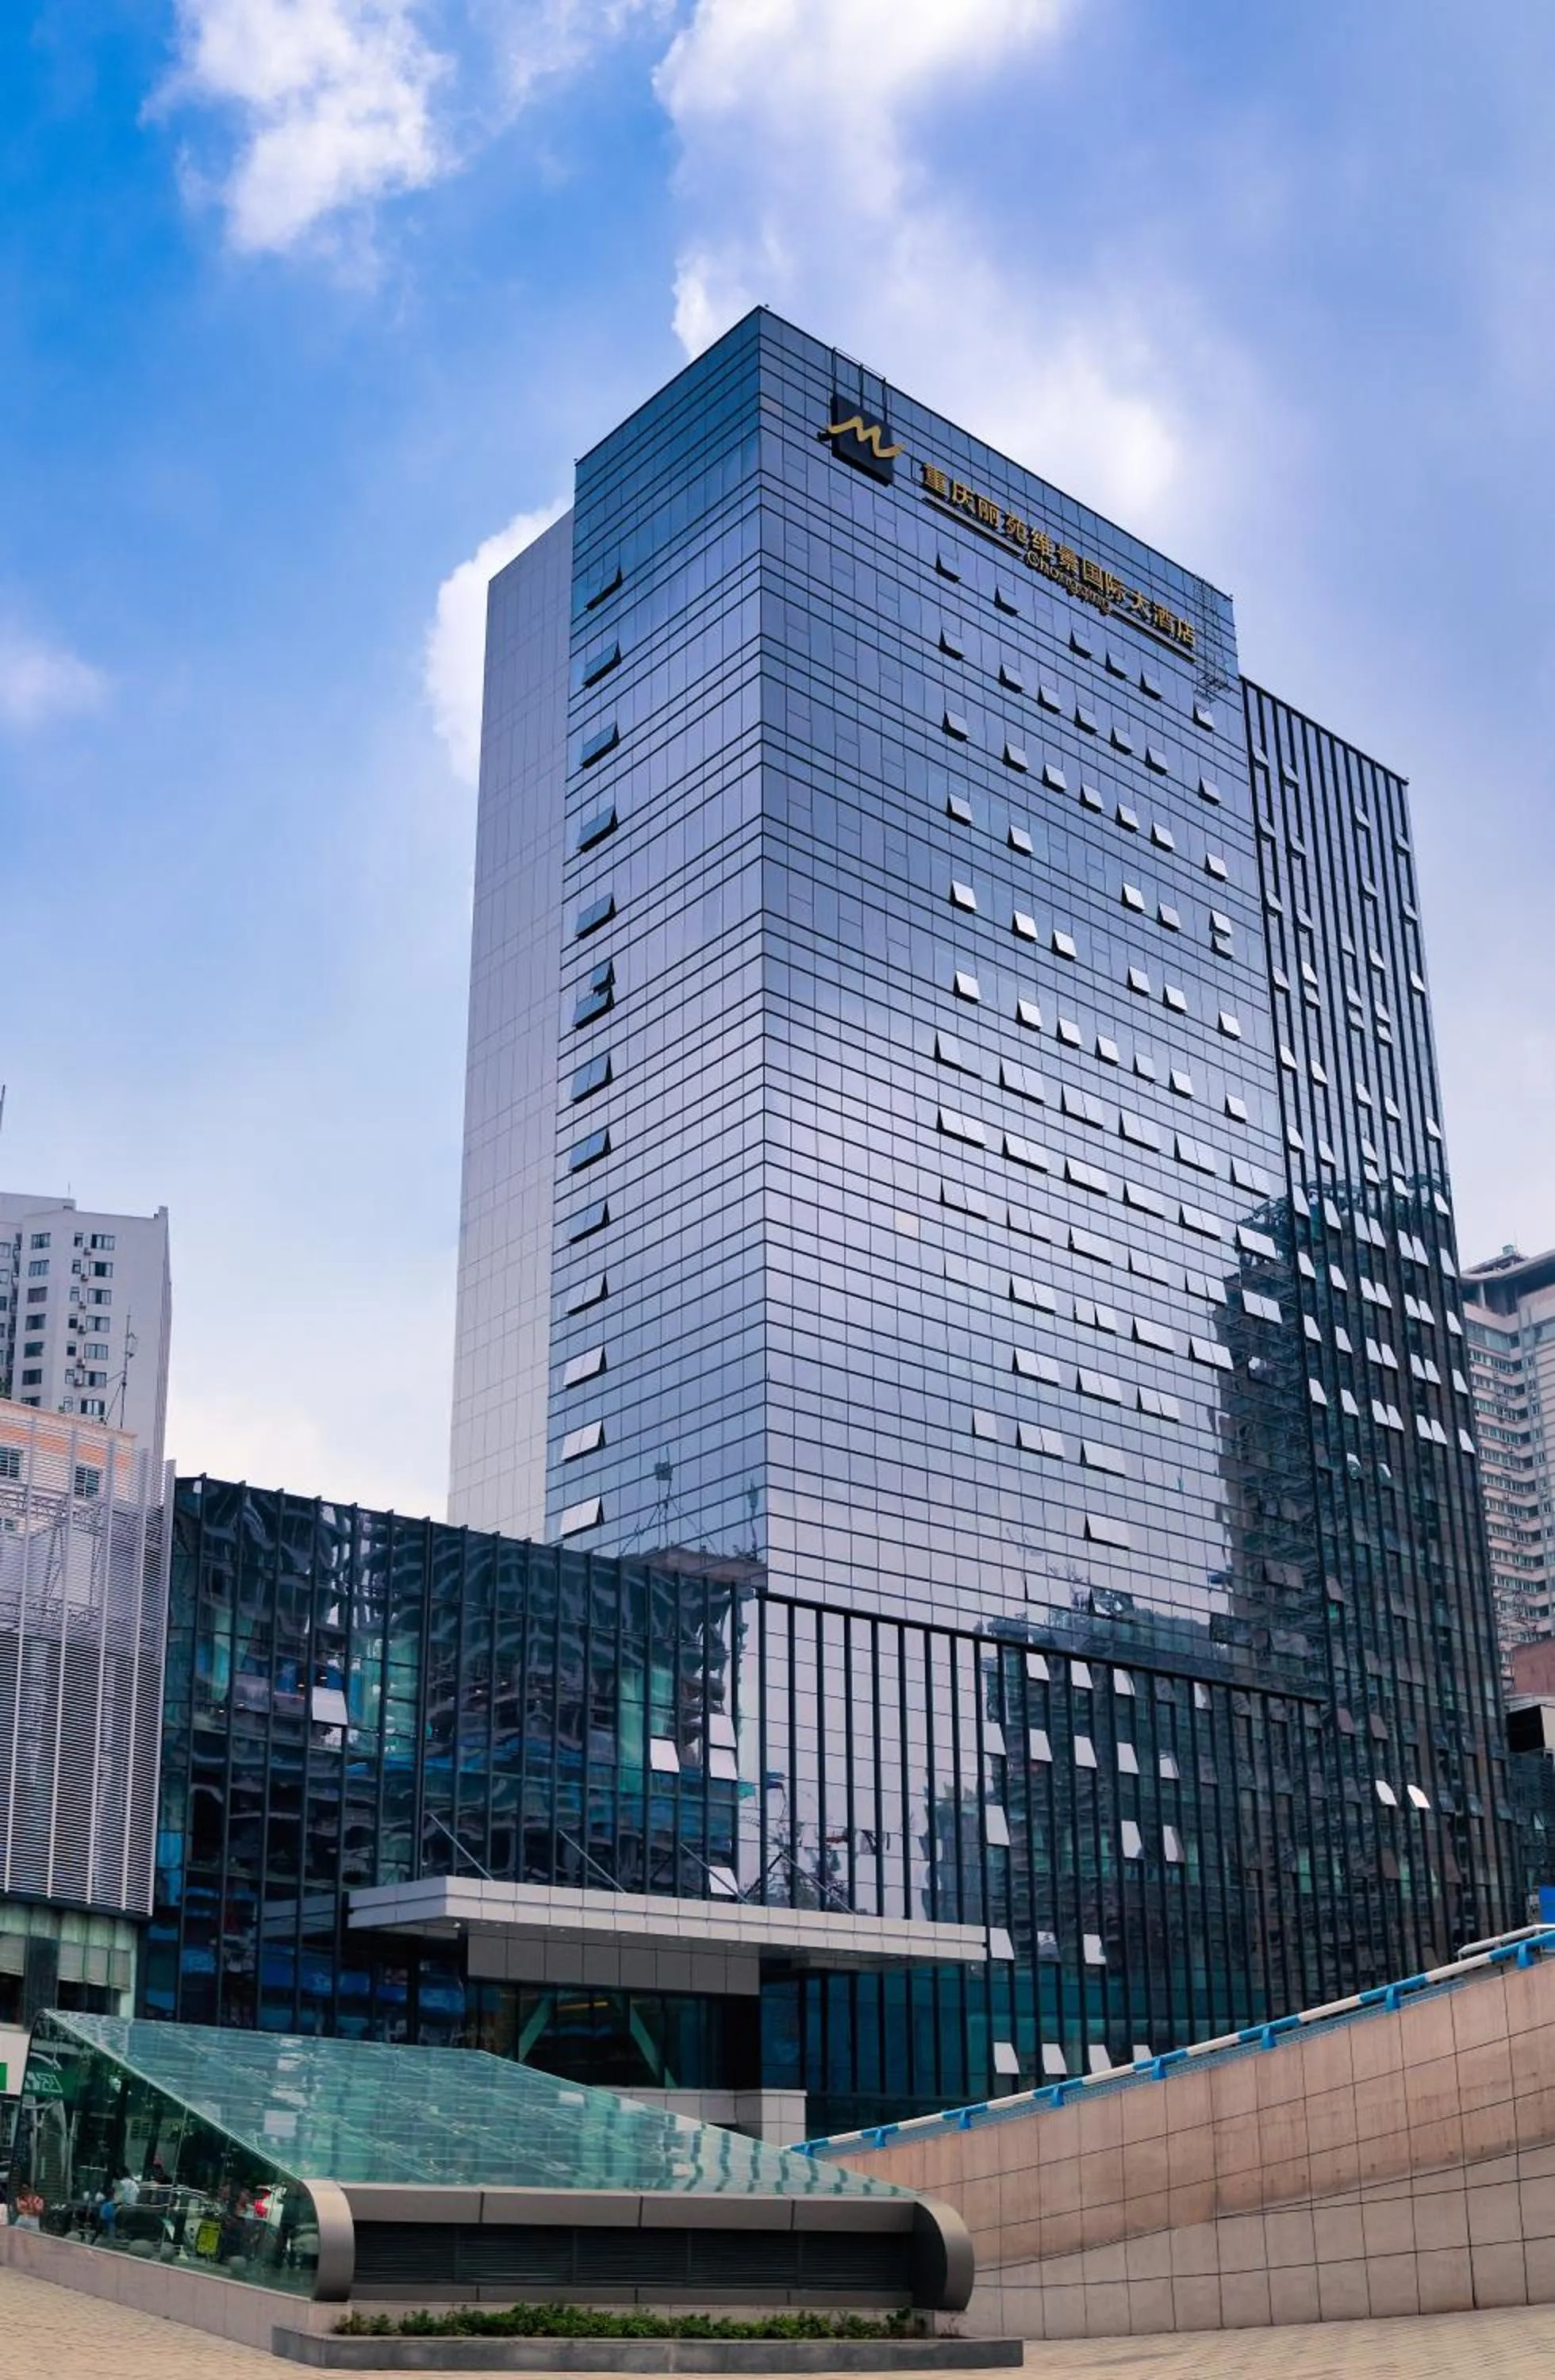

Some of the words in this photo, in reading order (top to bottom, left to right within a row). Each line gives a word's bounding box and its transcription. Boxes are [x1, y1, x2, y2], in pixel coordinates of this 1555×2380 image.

[923, 463, 1196, 647] 重庆丽苑维景国际大酒店
